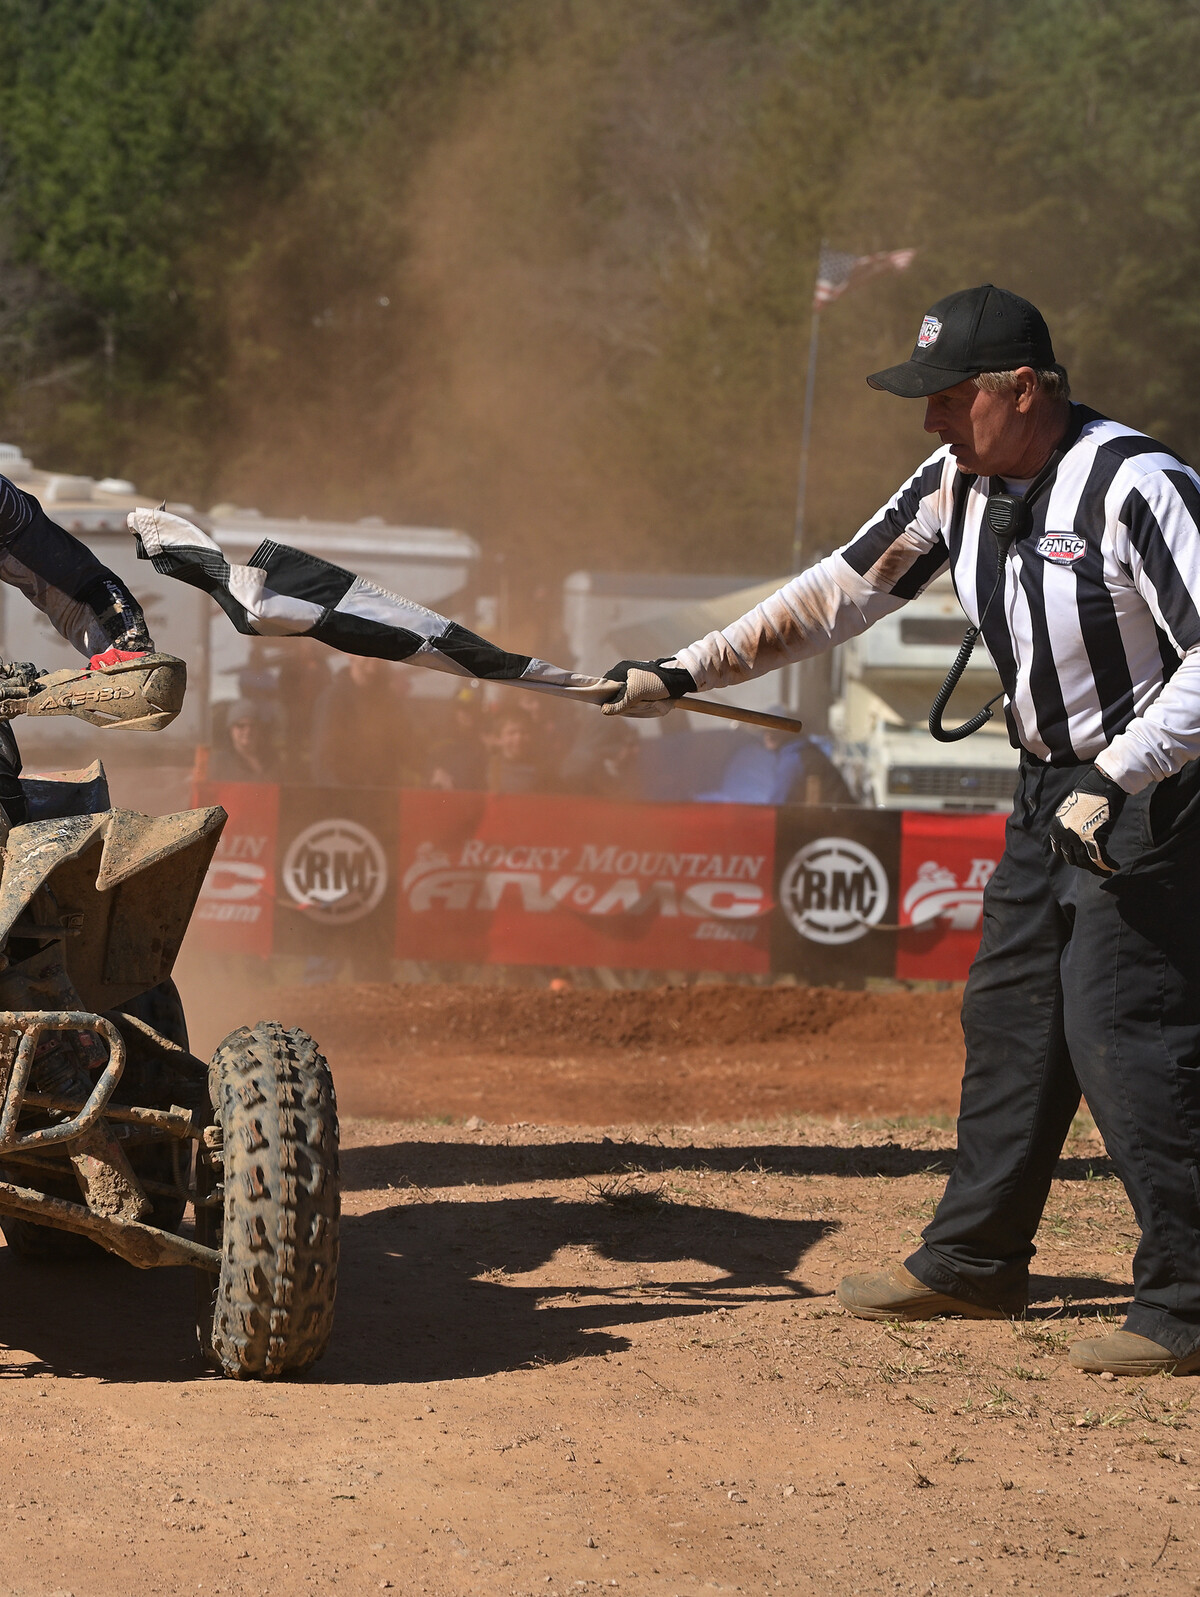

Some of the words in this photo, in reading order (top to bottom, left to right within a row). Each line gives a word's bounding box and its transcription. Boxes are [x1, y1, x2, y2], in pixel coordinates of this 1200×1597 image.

[1040, 539, 1084, 552] GNCC
[305, 849, 372, 892] RM
[458, 838, 569, 872] ROCKY
[575, 845, 766, 879] MOUNTAIN
[802, 869, 866, 911] RM
